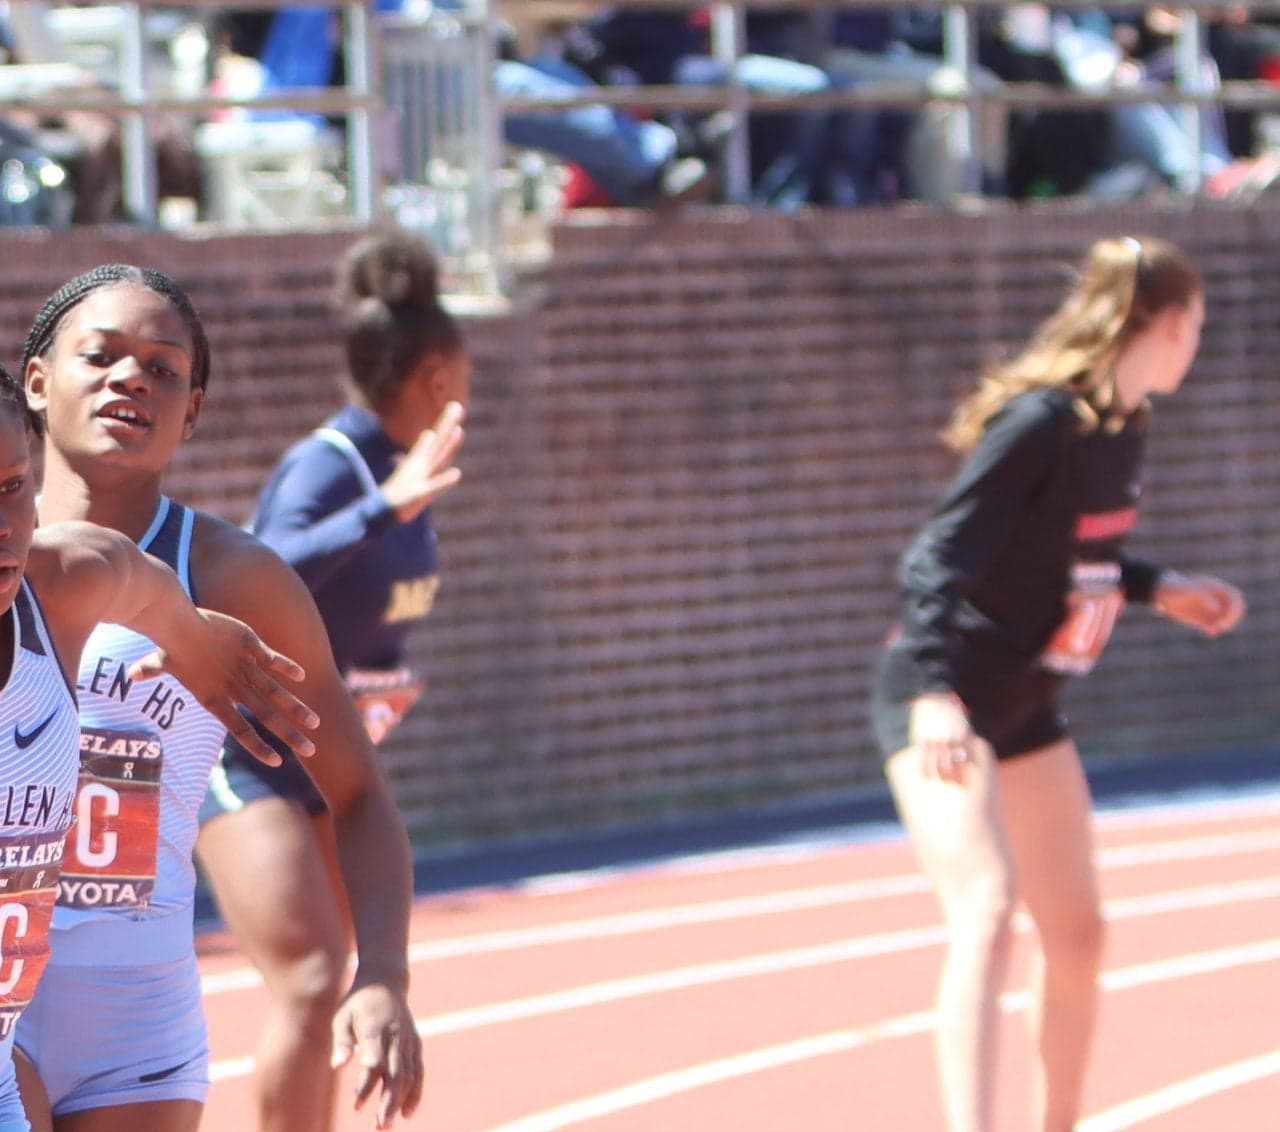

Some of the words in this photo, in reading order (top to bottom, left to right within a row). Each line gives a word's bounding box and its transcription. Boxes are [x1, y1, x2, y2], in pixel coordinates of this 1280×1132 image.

[141, 681, 186, 731] HS
[79, 733, 161, 759] ELAYS
[56, 881, 138, 905] YOTA
